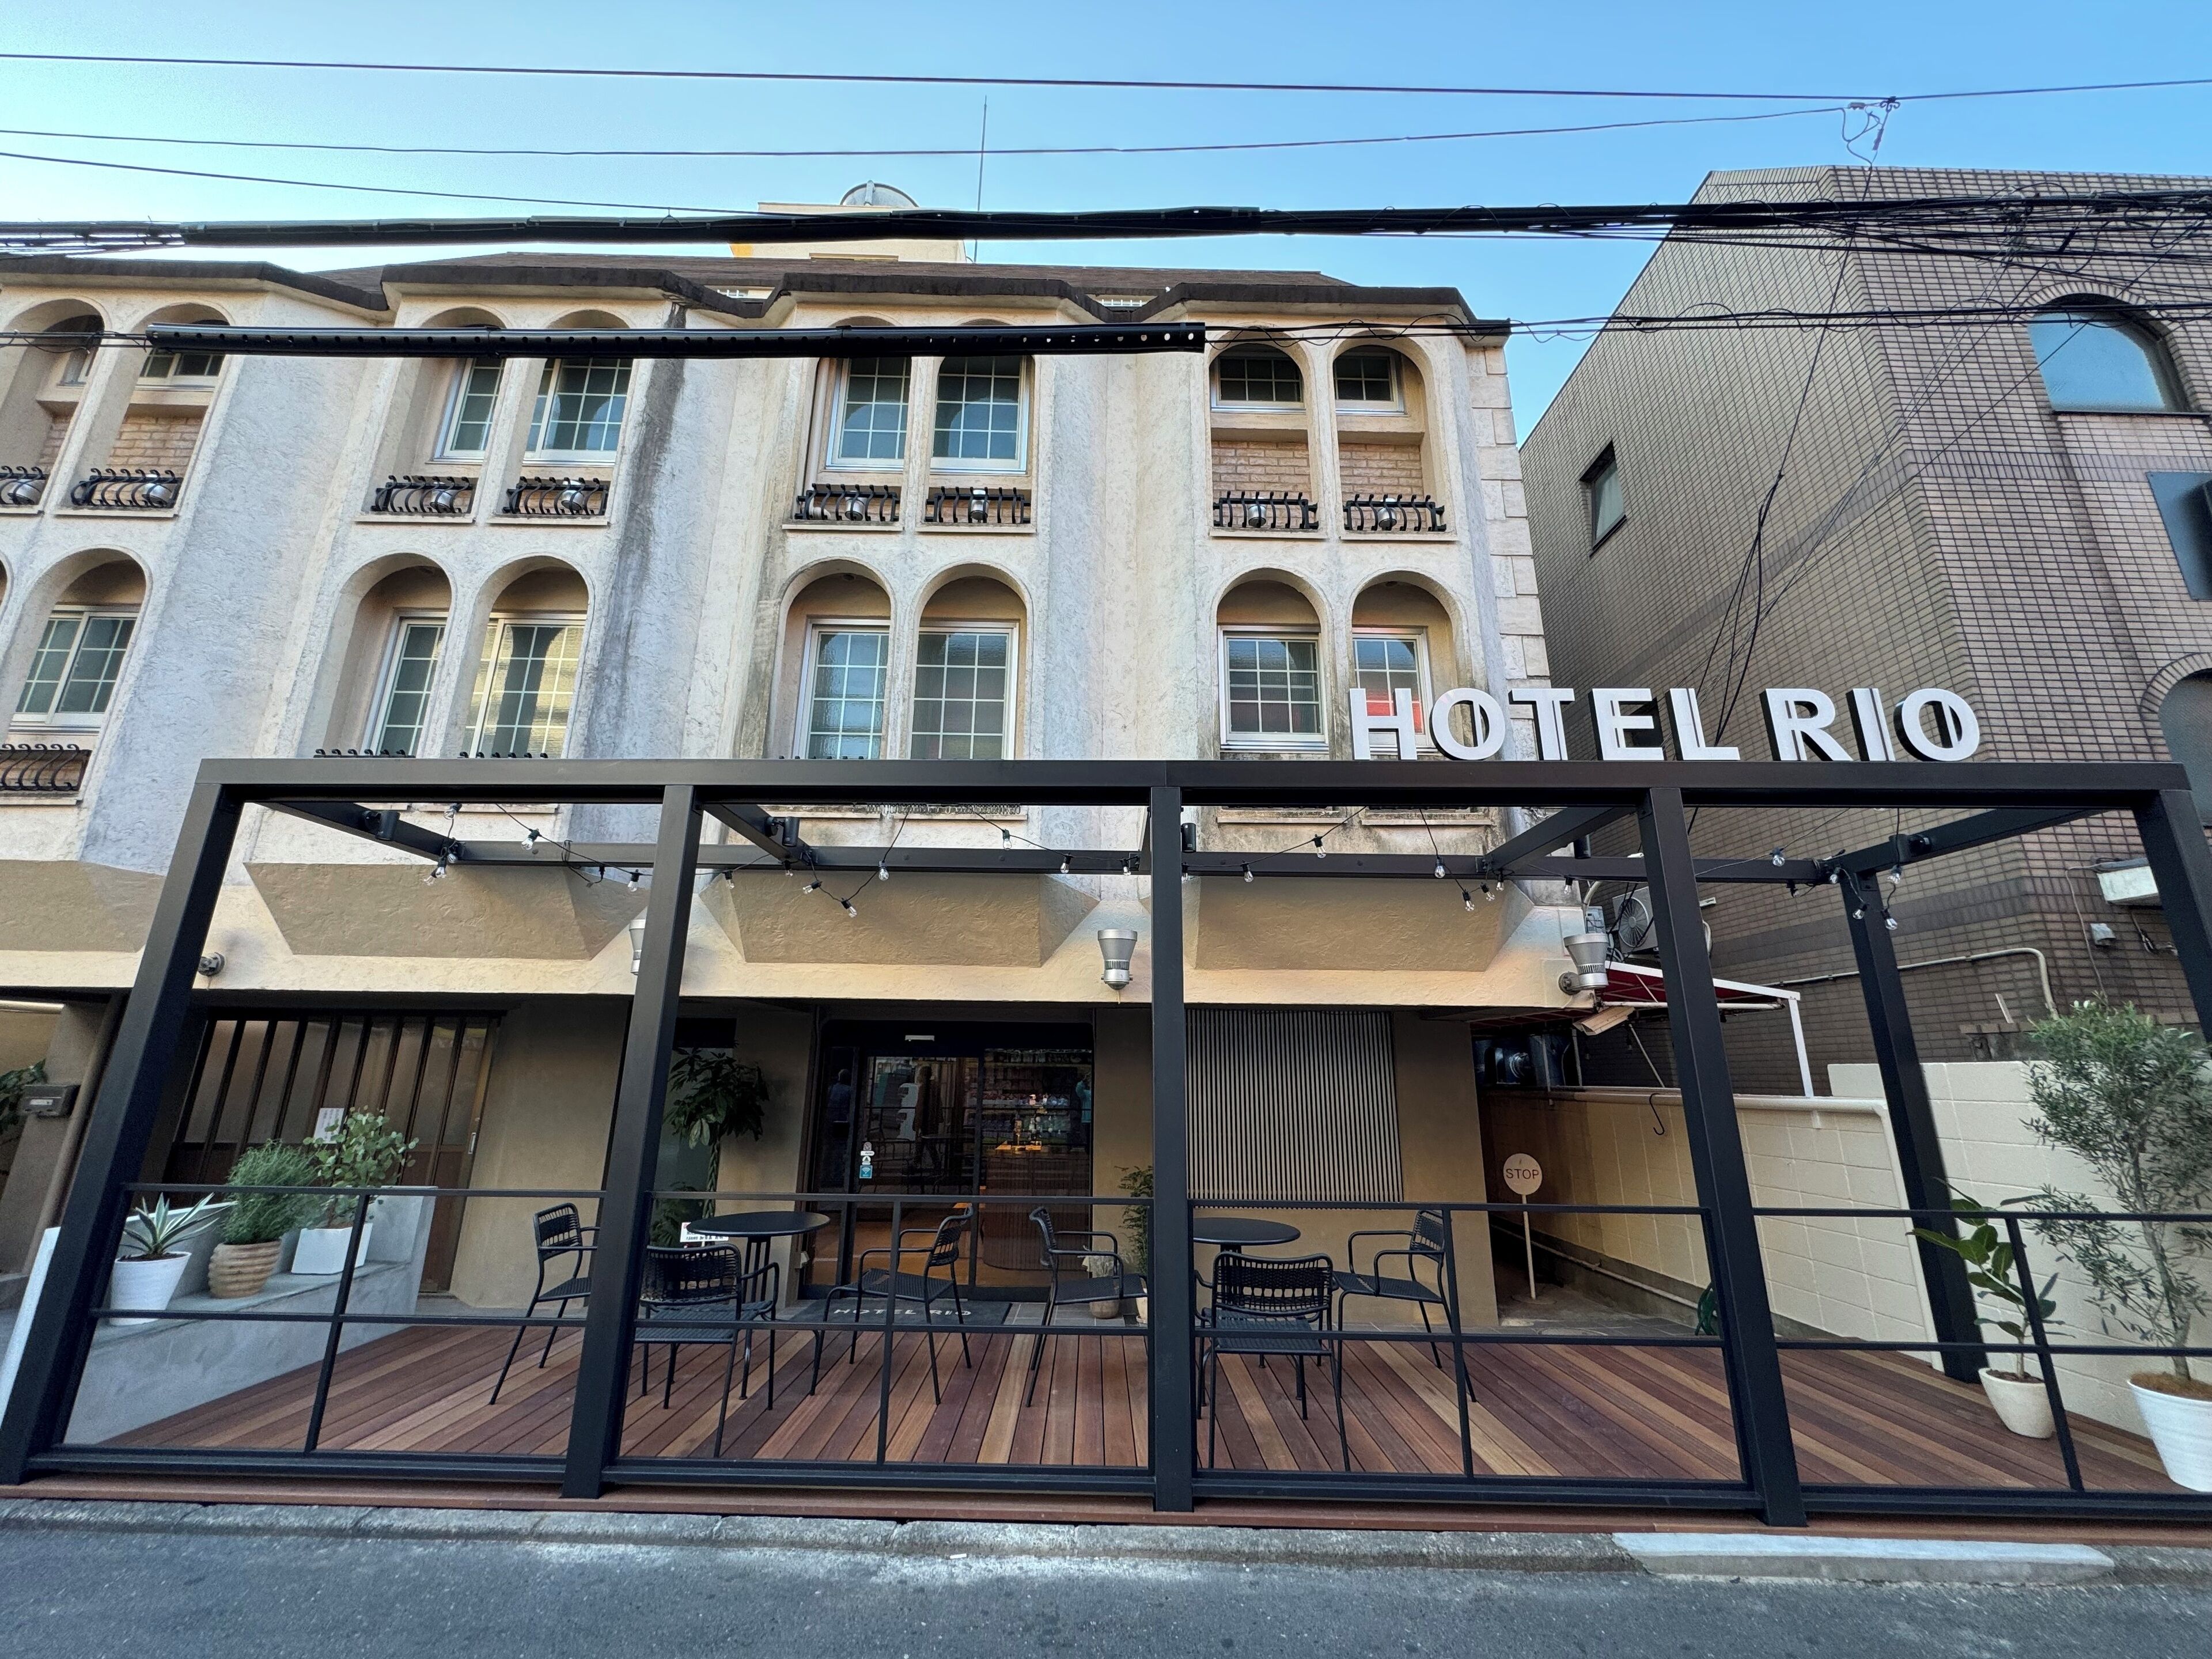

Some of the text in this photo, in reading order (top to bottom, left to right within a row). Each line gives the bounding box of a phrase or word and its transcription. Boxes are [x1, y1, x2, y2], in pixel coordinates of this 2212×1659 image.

[1349, 688, 1980, 762] HOTEL RIO
[1506, 1168, 1539, 1179] STOP
